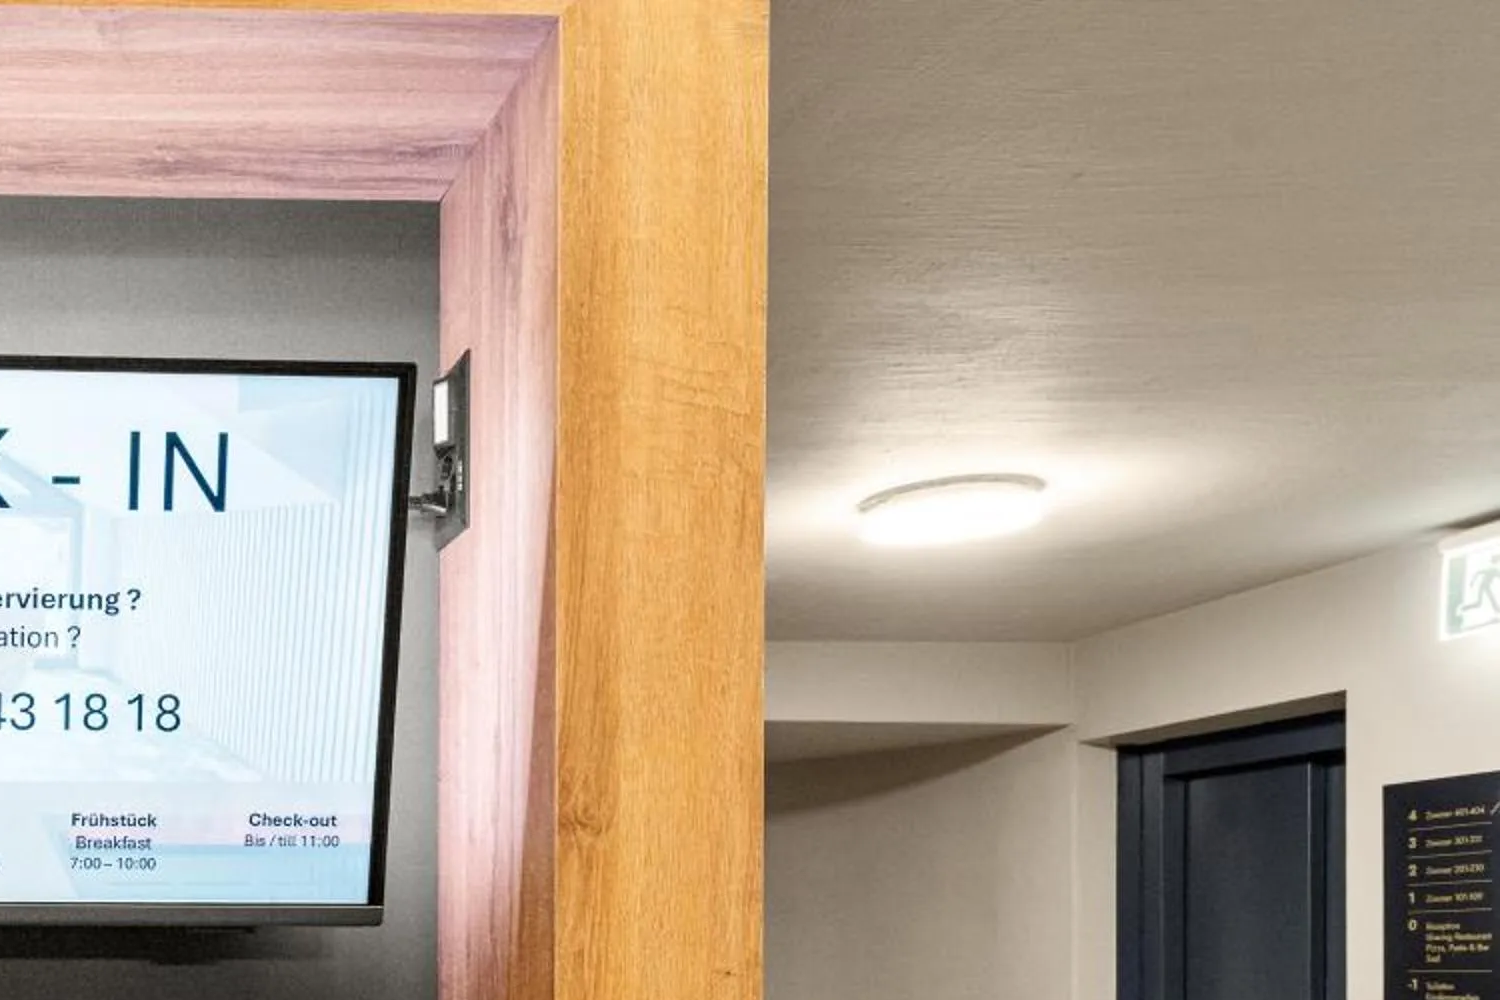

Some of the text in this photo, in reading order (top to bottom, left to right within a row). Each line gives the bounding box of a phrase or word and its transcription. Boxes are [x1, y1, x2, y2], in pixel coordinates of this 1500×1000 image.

[52, 476, 81, 485] -
[128, 430, 230, 512] IN
[127, 588, 142, 610] ?
[67, 626, 82, 647] ?
[54, 693, 109, 732] 18
[126, 693, 182, 733] 18
[71, 812, 157, 828] Frühstück
[249, 812, 338, 828] Check-out
[1408, 809, 1418, 821] 4
[75, 835, 153, 851] Breakfast
[244, 834, 266, 848] Bis
[279, 834, 297, 848] till
[301, 834, 340, 848] 11:00
[1408, 837, 1417, 849] 3
[70, 857, 102, 871] 7:00
[118, 857, 157, 871] 10:00
[1408, 863, 1417, 877] 2
[1408, 892, 1415, 904] 1
[1407, 919, 1418, 931] 0
[1407, 978, 1418, 992] -1
